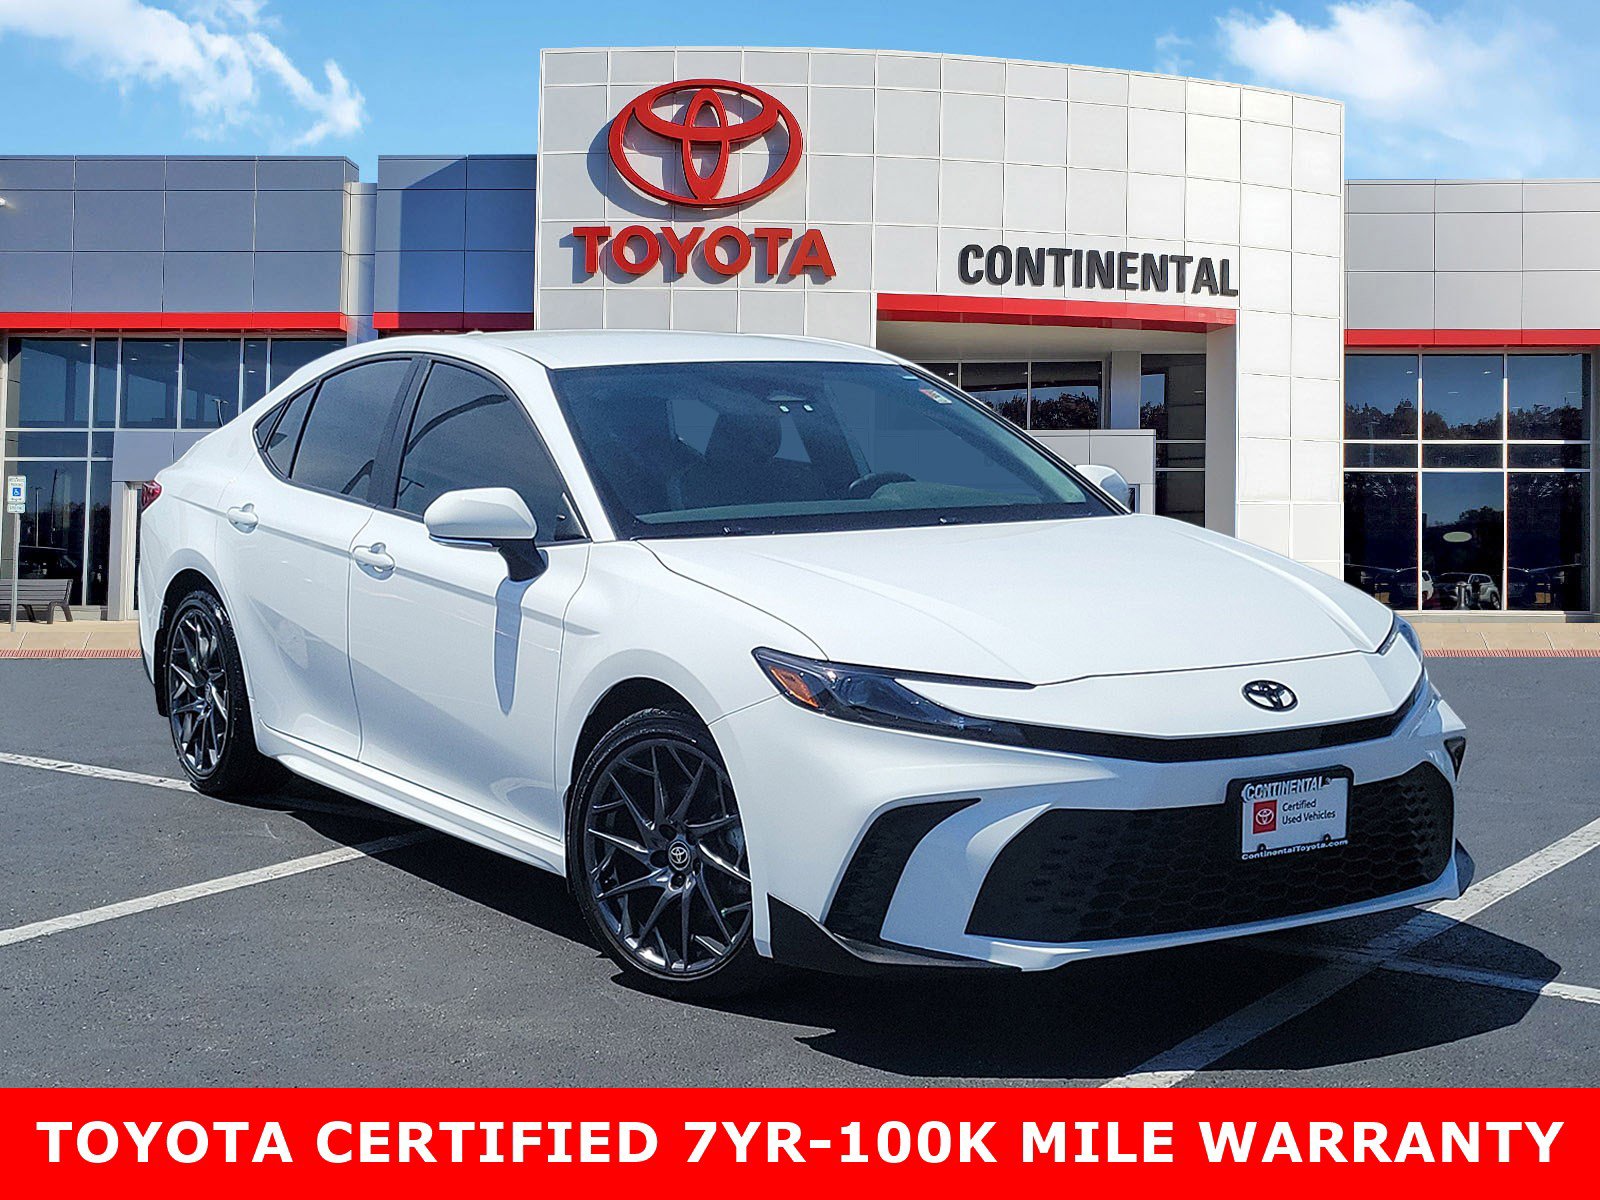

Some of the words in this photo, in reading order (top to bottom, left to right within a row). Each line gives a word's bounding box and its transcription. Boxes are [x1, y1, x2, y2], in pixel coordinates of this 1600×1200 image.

[573, 226, 836, 277] TOYOTA
[958, 244, 1238, 297] CONTINENTAL
[1241, 776, 1323, 803] CONTINENTAL
[1282, 799, 1317, 812] Certified
[1282, 814, 1302, 825] Used
[1303, 809, 1336, 822] Vehicles
[1241, 839, 1349, 860] ContinentalToyota.com
